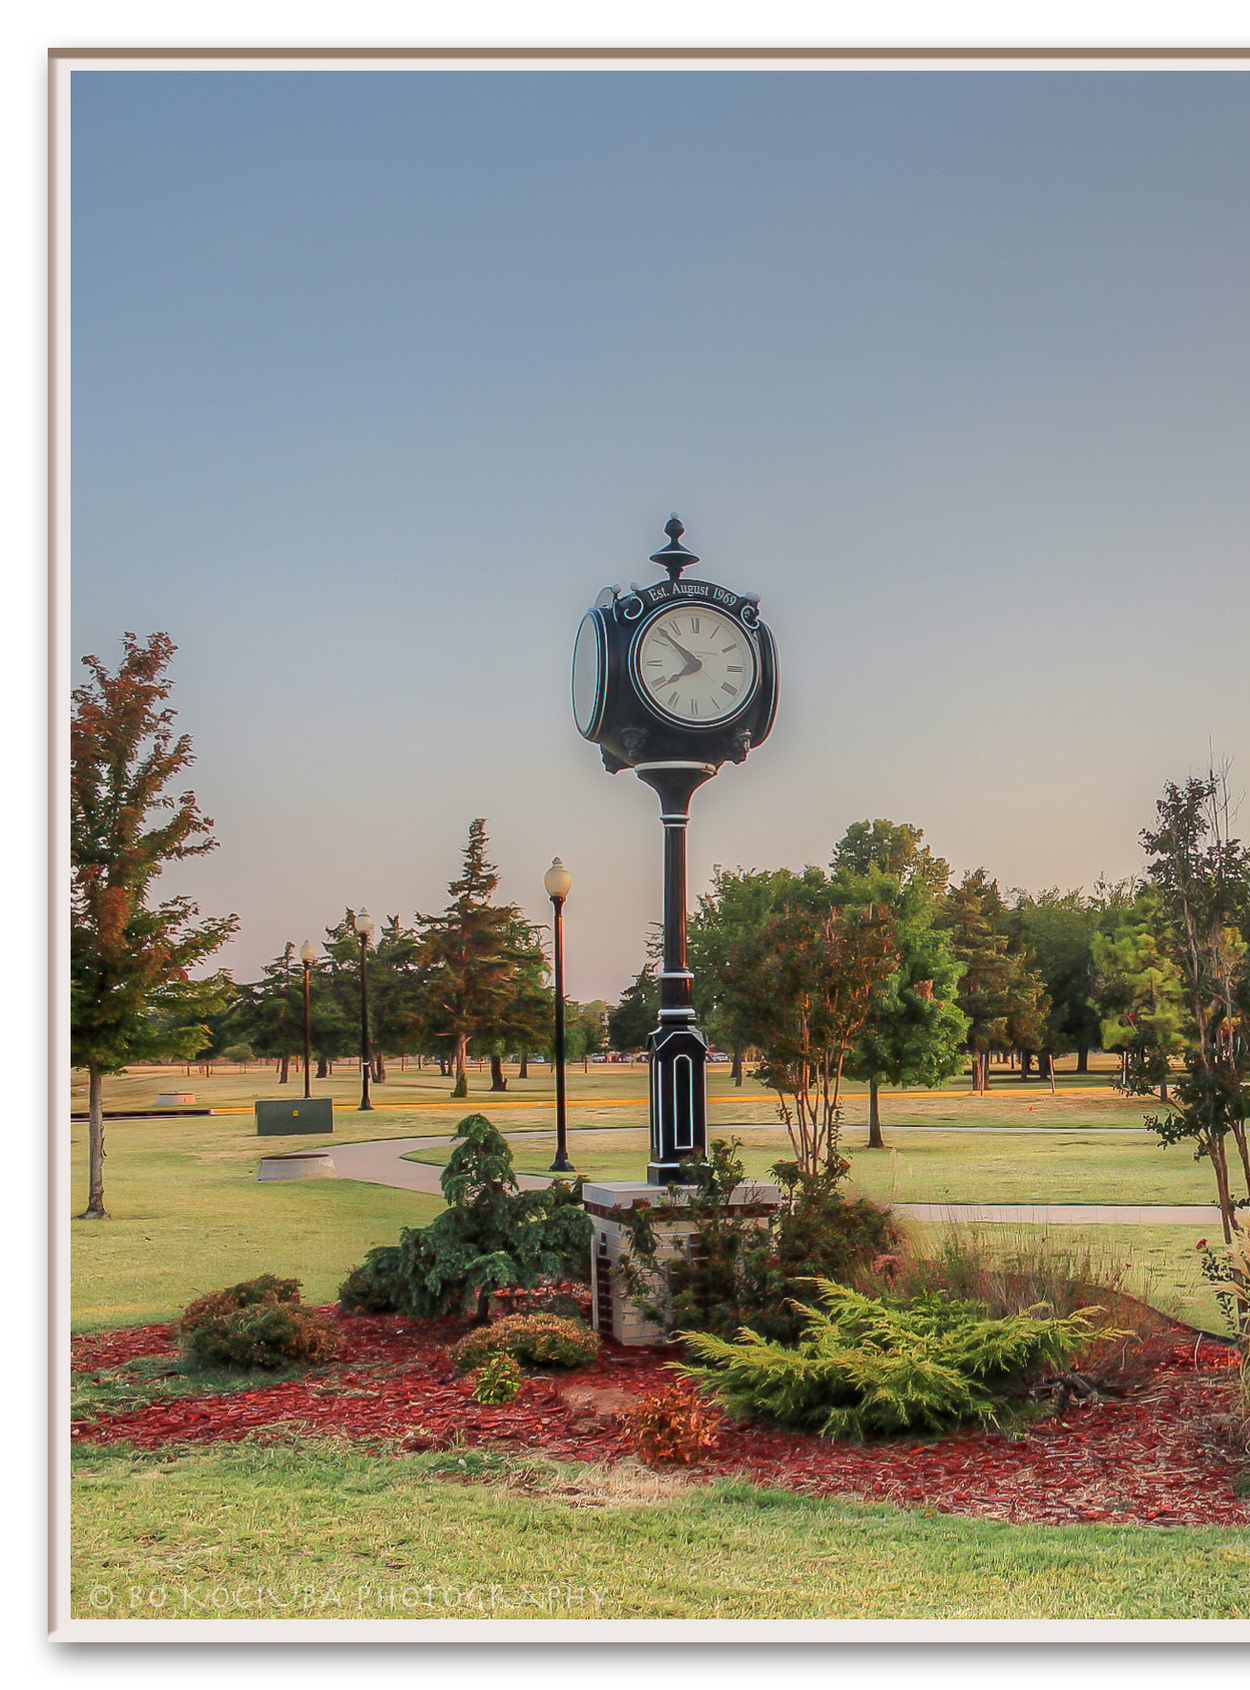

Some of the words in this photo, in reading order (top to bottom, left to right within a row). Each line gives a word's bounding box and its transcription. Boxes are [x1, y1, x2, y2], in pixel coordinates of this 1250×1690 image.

[648, 587, 670, 602] Est.
[672, 582, 709, 597] August
[712, 587, 737, 606] 1969
